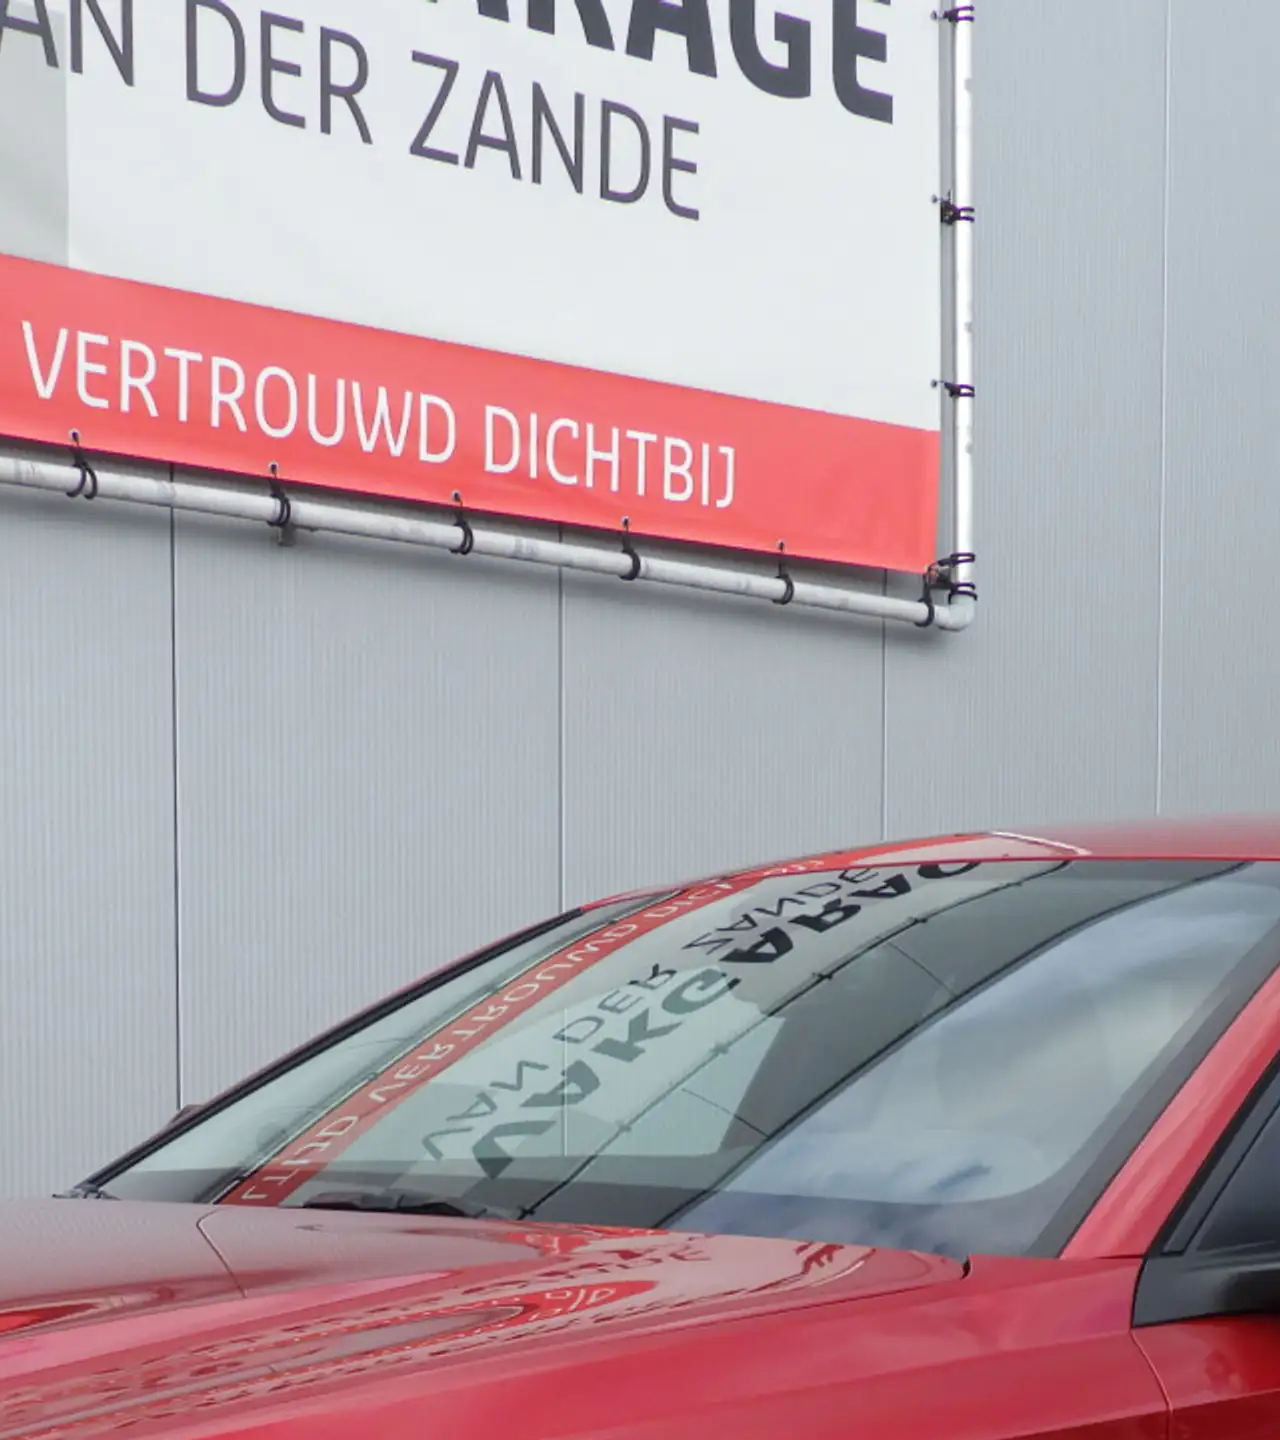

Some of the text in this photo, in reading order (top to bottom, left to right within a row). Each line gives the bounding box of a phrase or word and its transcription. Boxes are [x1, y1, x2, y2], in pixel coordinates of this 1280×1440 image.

[186, 0, 373, 145] DER
[409, 50, 699, 220] ZANDE
[23, 321, 455, 465] VERTROUWD
[485, 405, 736, 508] DICHTBIJ
